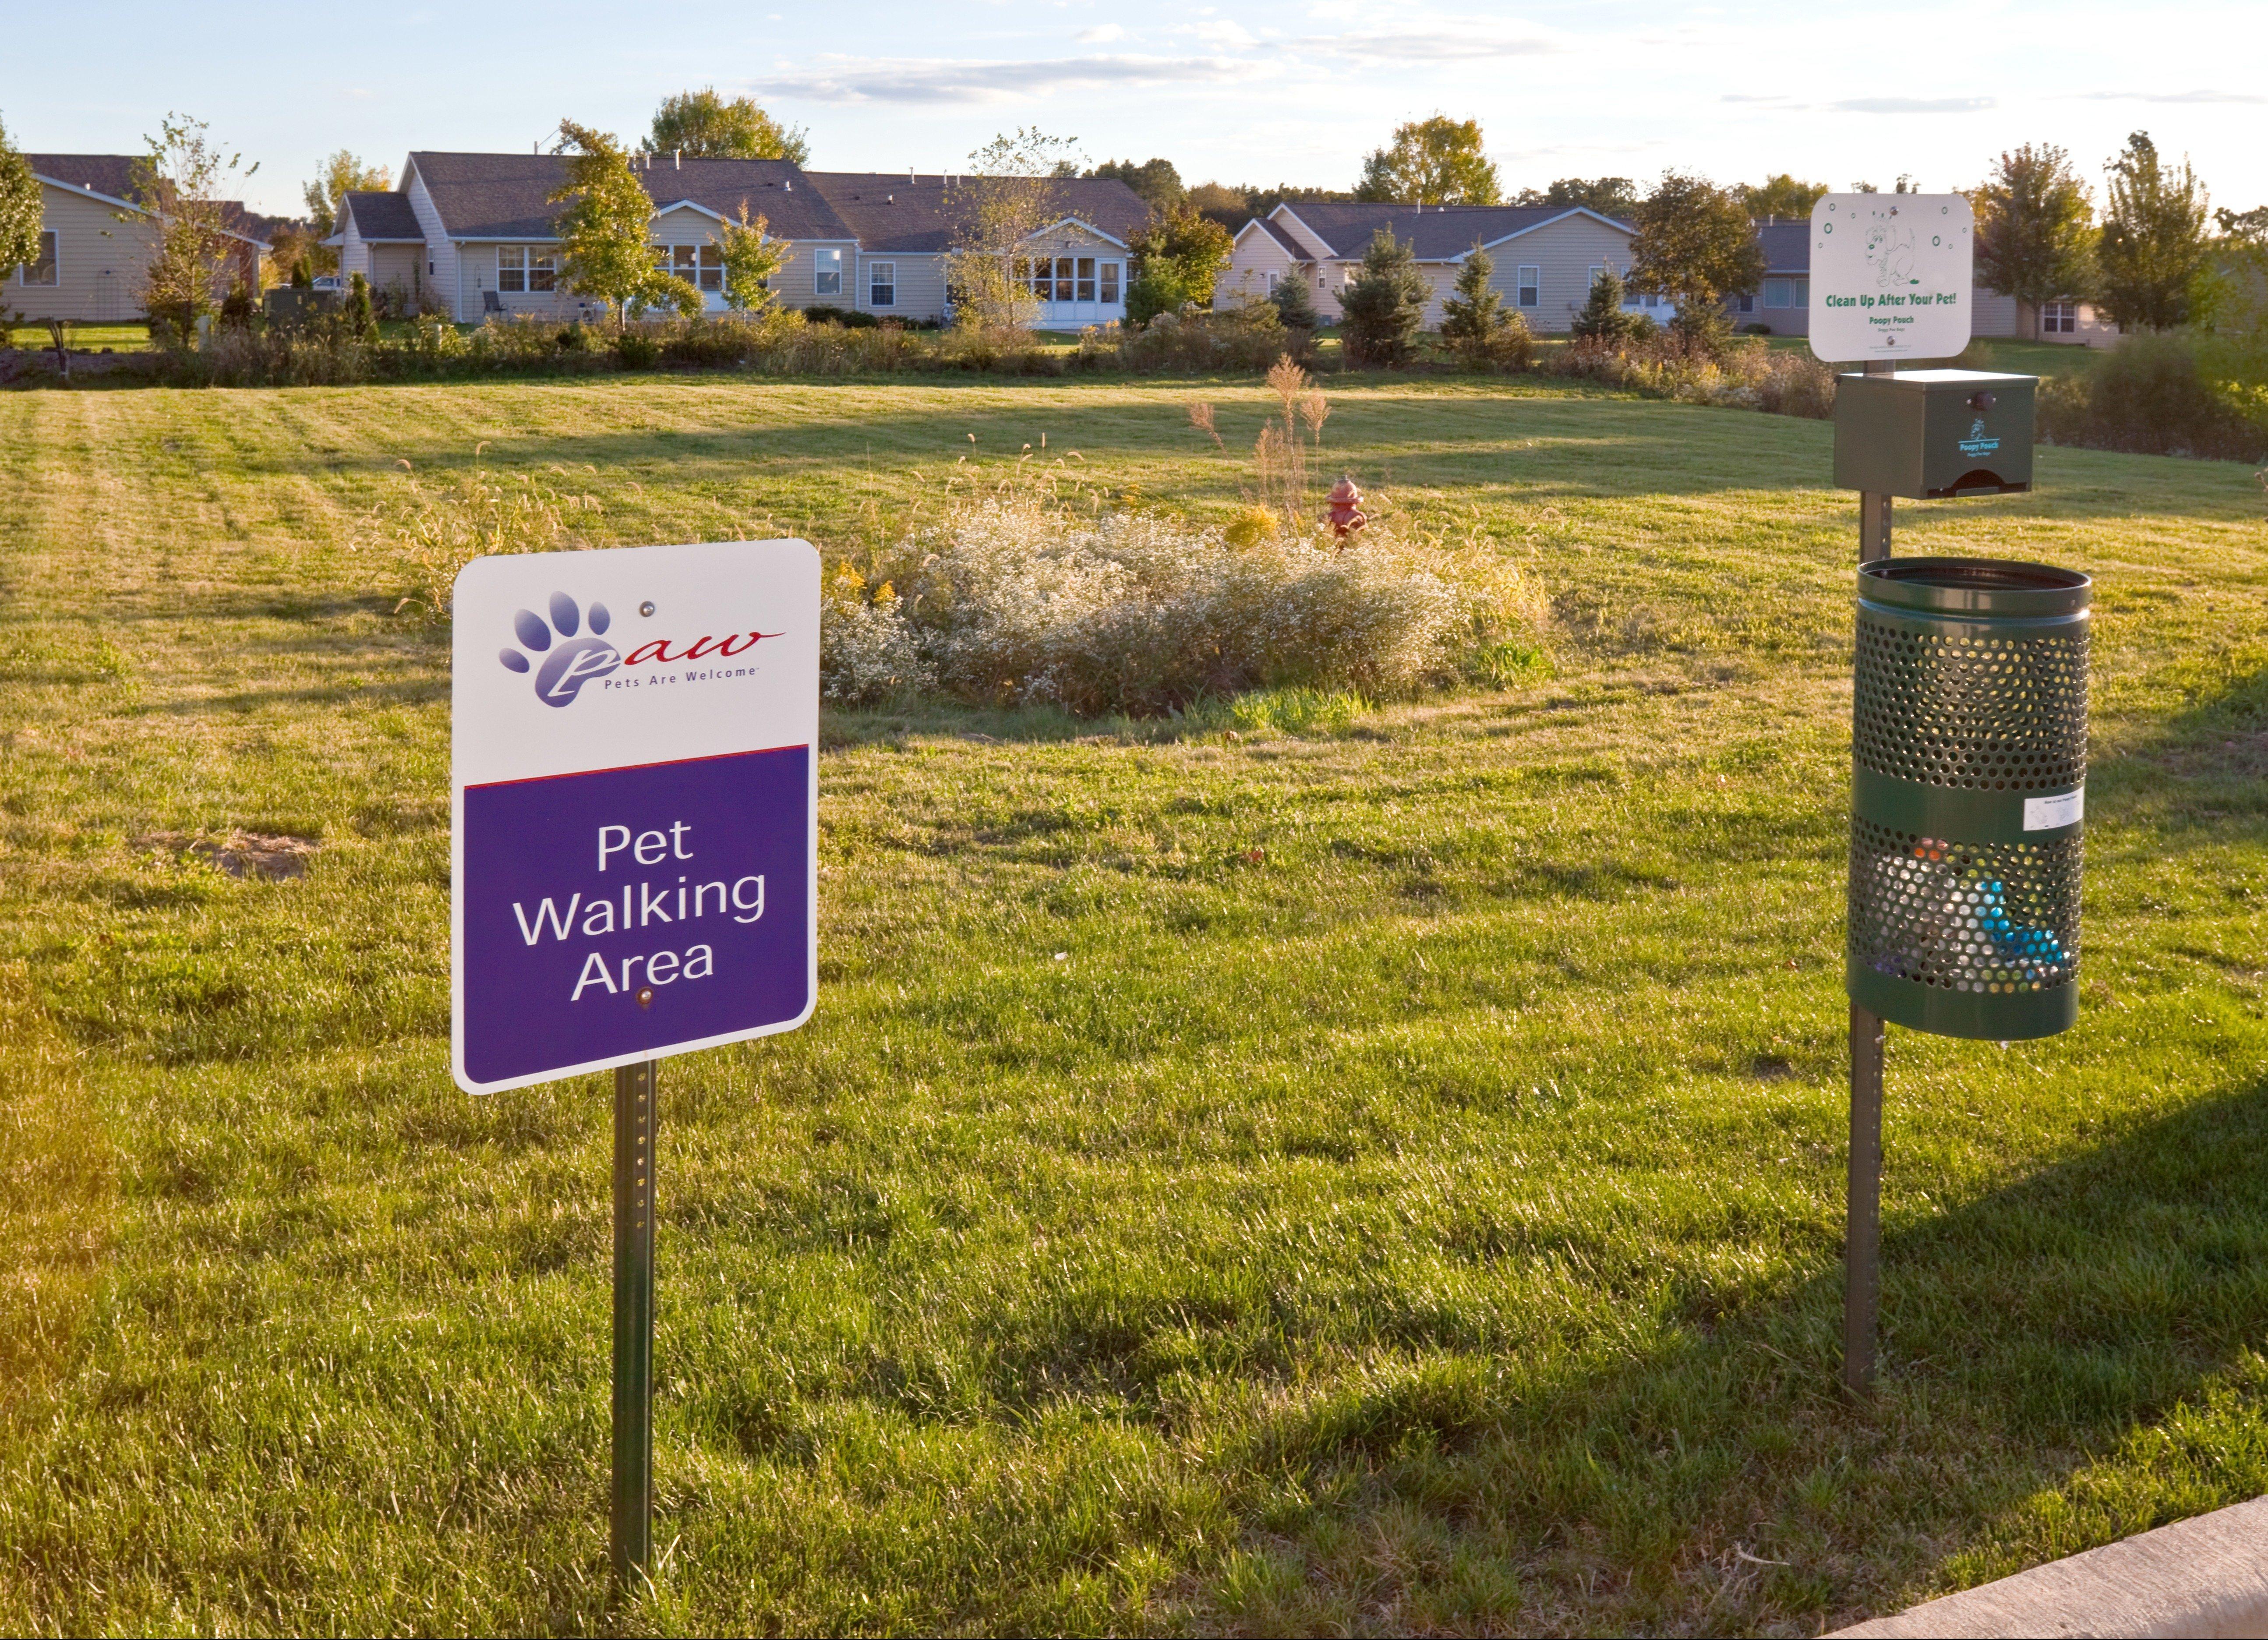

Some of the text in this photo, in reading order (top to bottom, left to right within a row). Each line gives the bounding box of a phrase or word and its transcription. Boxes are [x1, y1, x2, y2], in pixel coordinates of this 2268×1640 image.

[1826, 293, 1957, 309] Clean Up After Your Pet!
[1869, 315, 1914, 325] Poopy Pouch
[1960, 443, 1979, 452] Poopy
[604, 678, 639, 689] Pets
[649, 675, 676, 686] Are
[598, 821, 693, 871] Pet
[512, 875, 764, 946] Walking
[570, 944, 713, 1001] Area
